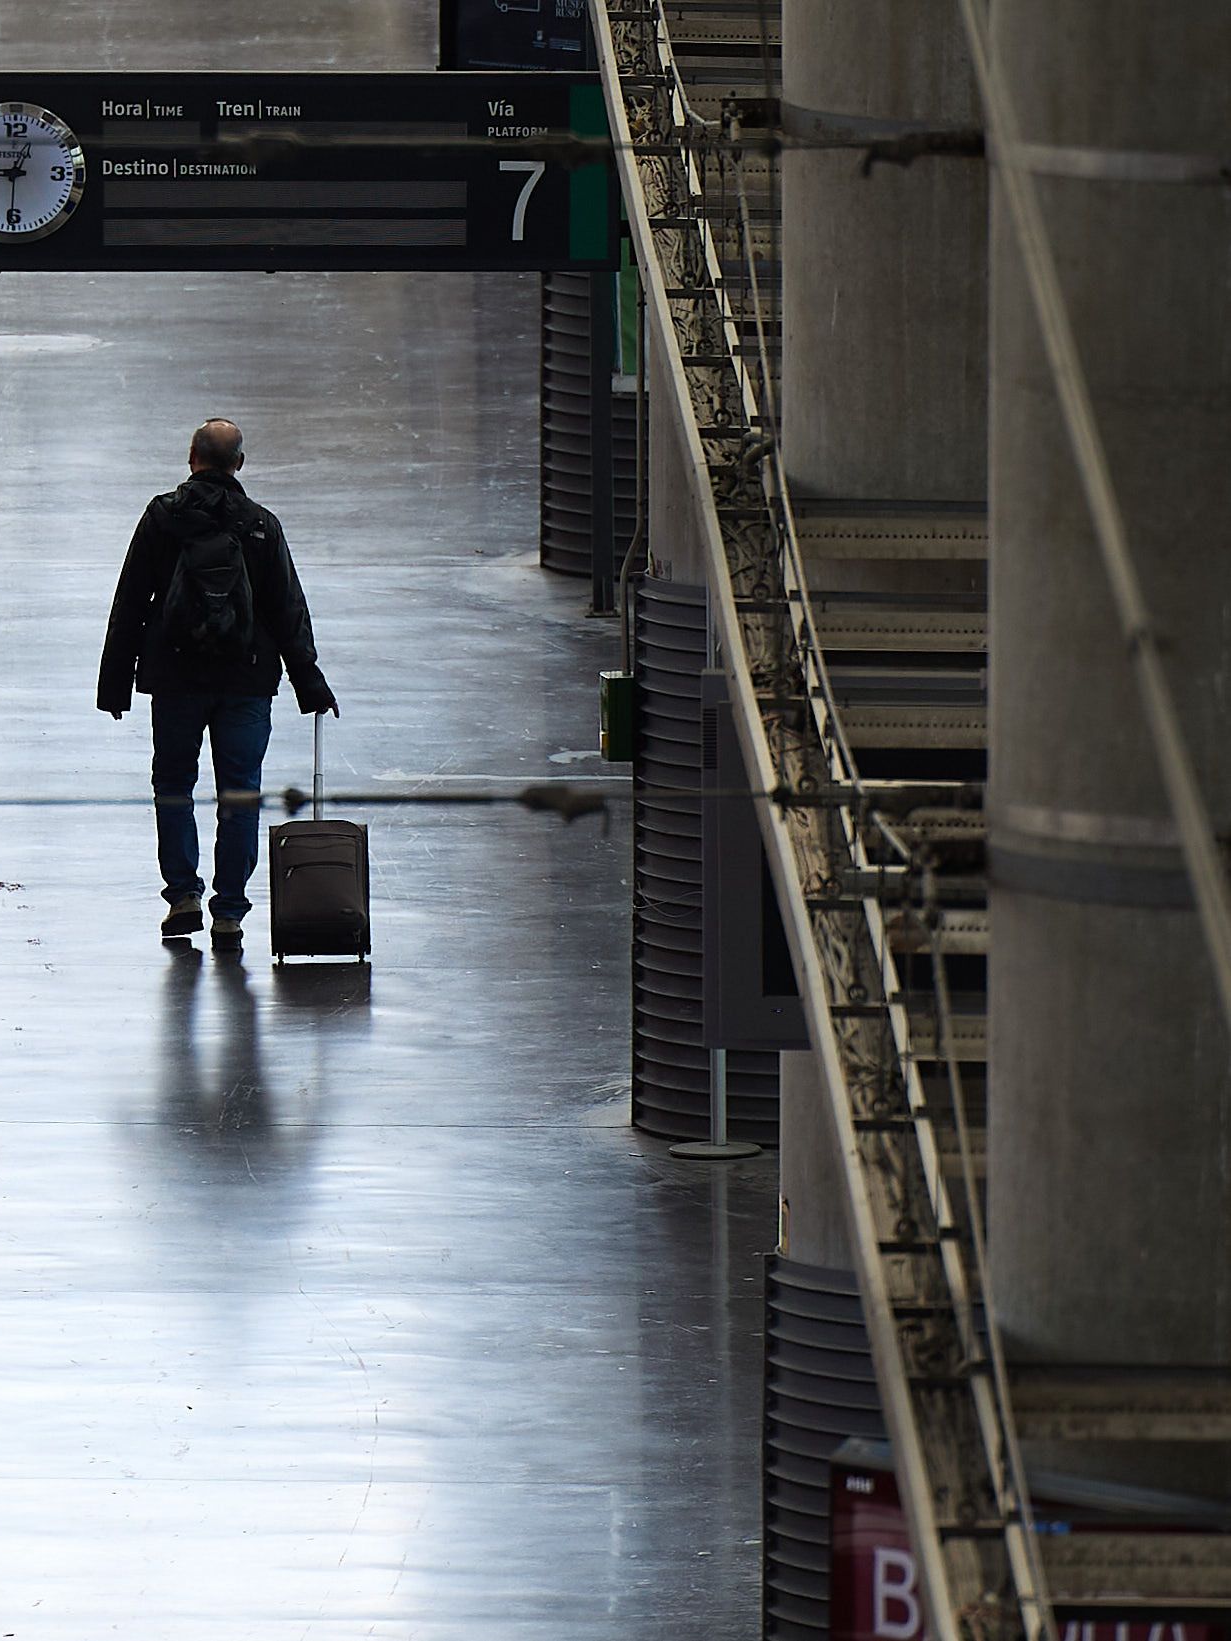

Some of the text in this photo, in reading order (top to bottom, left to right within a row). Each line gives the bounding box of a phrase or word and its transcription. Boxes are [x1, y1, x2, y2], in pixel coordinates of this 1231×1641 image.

[101, 100, 184, 117] Hora TIME
[216, 101, 301, 117] Tren TRAIN
[487, 99, 515, 117] Vía
[4, 123, 28, 138] 12
[487, 126, 549, 138] PLATFORM
[50, 166, 66, 182] 3
[101, 159, 257, 176] Destino DESTINATION
[499, 160, 546, 241] 7
[6, 209, 21, 225] 6
